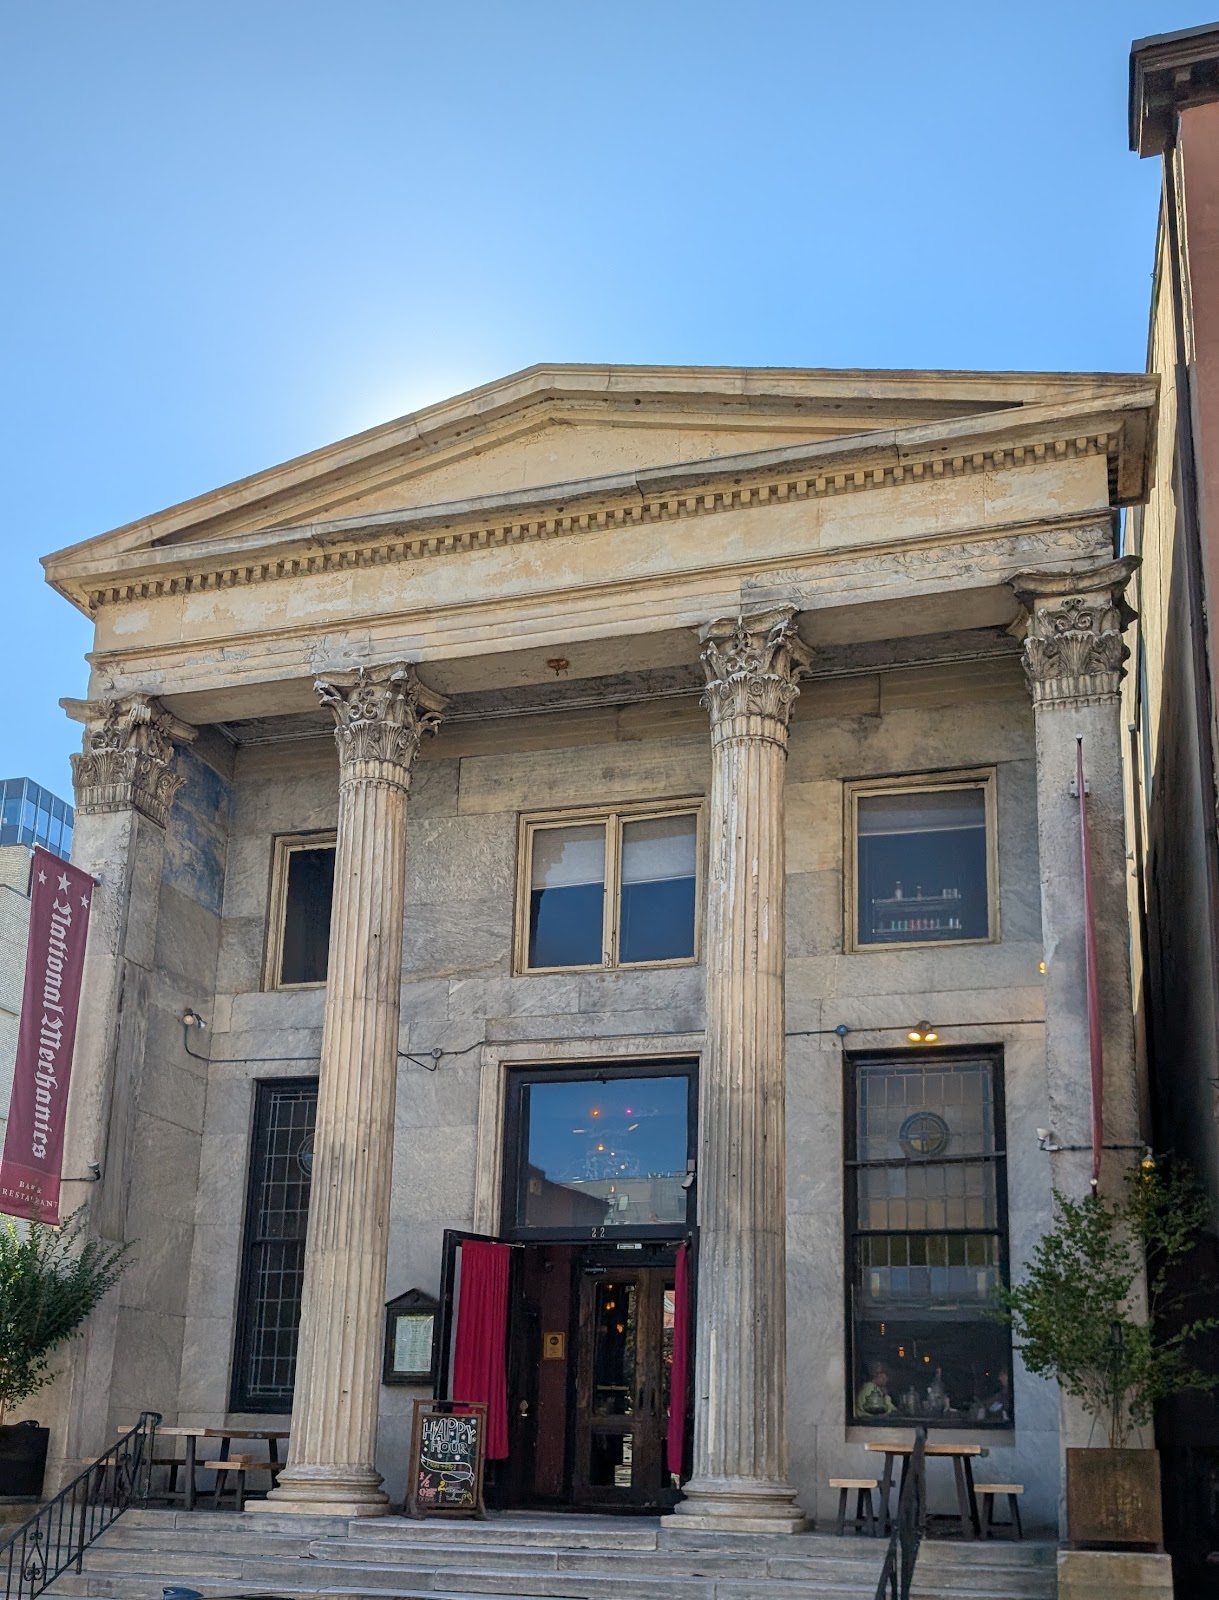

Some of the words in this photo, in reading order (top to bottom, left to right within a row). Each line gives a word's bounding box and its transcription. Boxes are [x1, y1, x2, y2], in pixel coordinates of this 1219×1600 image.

[43, 897, 72, 1015] National
[32, 1013, 64, 1160] Mechanics
[591, 1227, 605, 1238] 22
[422, 1418, 476, 1444] HAPPY
[431, 1441, 469, 1455] HOUR
